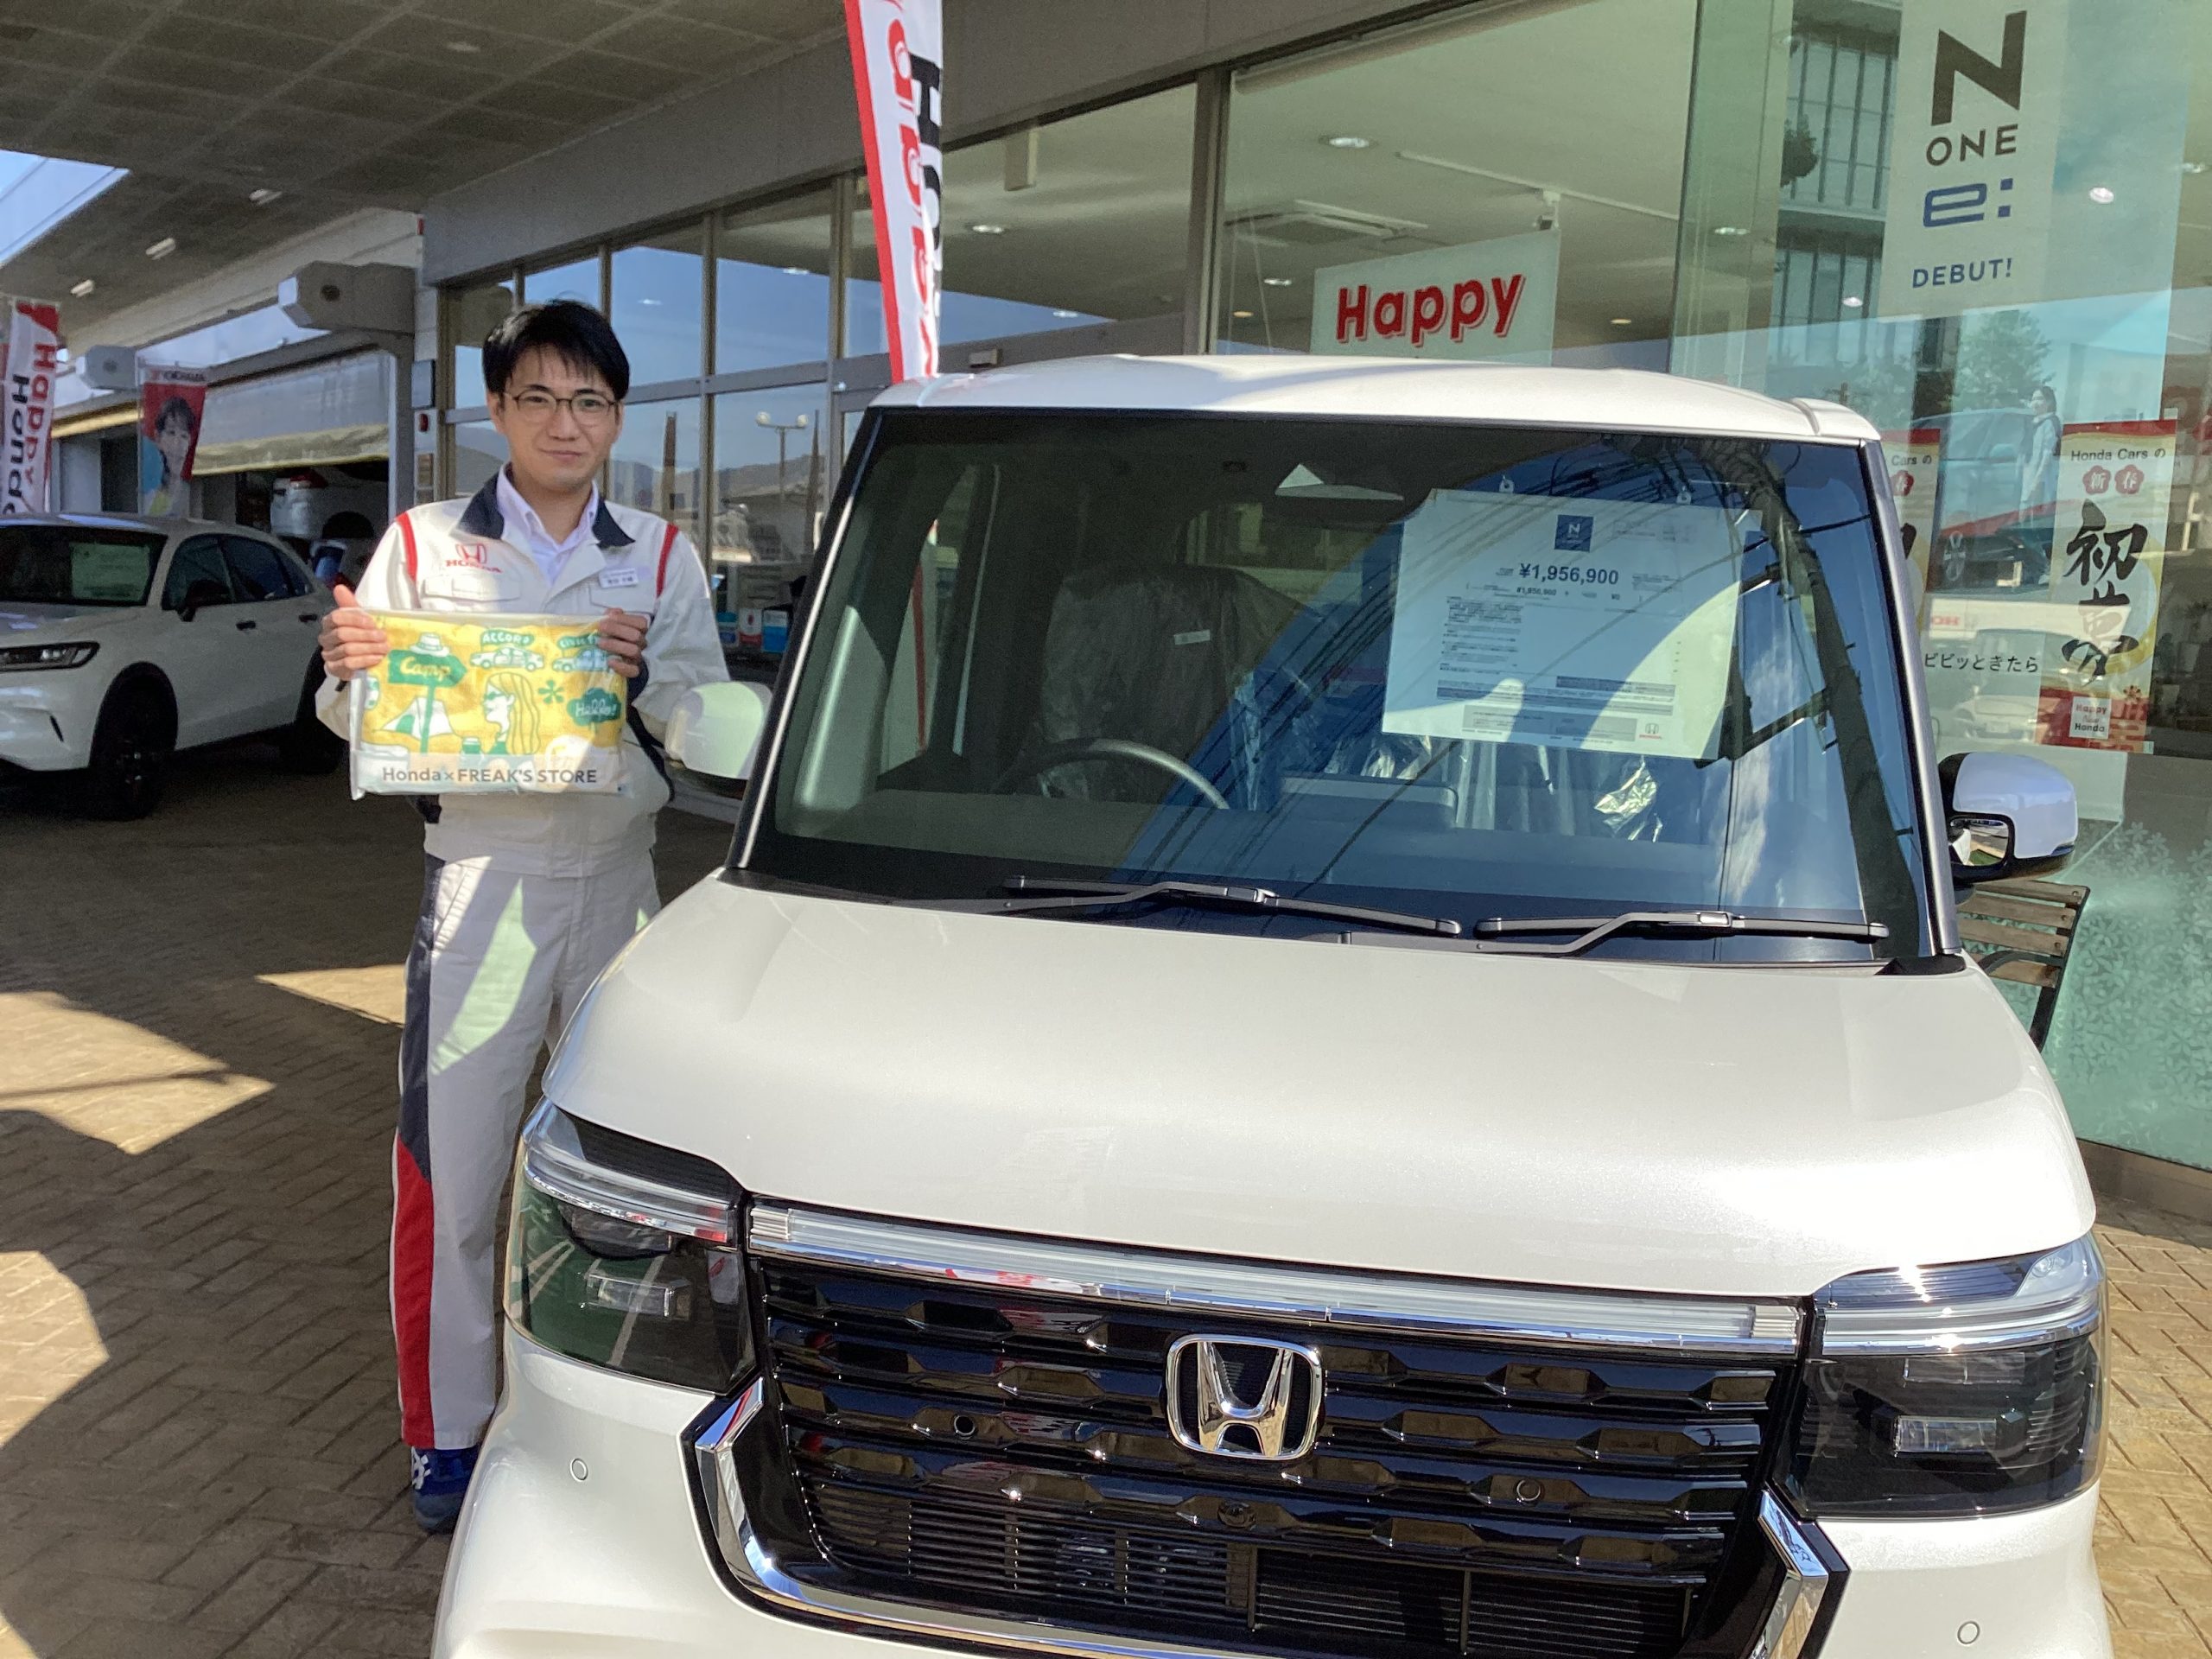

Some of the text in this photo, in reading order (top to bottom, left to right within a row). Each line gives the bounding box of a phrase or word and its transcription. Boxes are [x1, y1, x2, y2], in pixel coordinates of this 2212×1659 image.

[1931, 10, 2027, 126] N
[1926, 124, 2018, 166] ONE
[1912, 258, 2012, 288] DEBUT!
[1337, 274, 1526, 347] Happy
[25, 343, 56, 485] Happy
[1891, 454, 1917, 466] Cars
[2071, 448, 2165, 461] Honda Cars の
[1519, 563, 1619, 586] ¥1,956,900
[482, 632, 531, 644] ACCORD
[2075, 703, 2108, 715] Happy
[2075, 722, 2106, 733] Honda
[383, 767, 441, 782] Honda
[458, 768, 532, 782] FREAK'S
[538, 769, 597, 783] STORE
